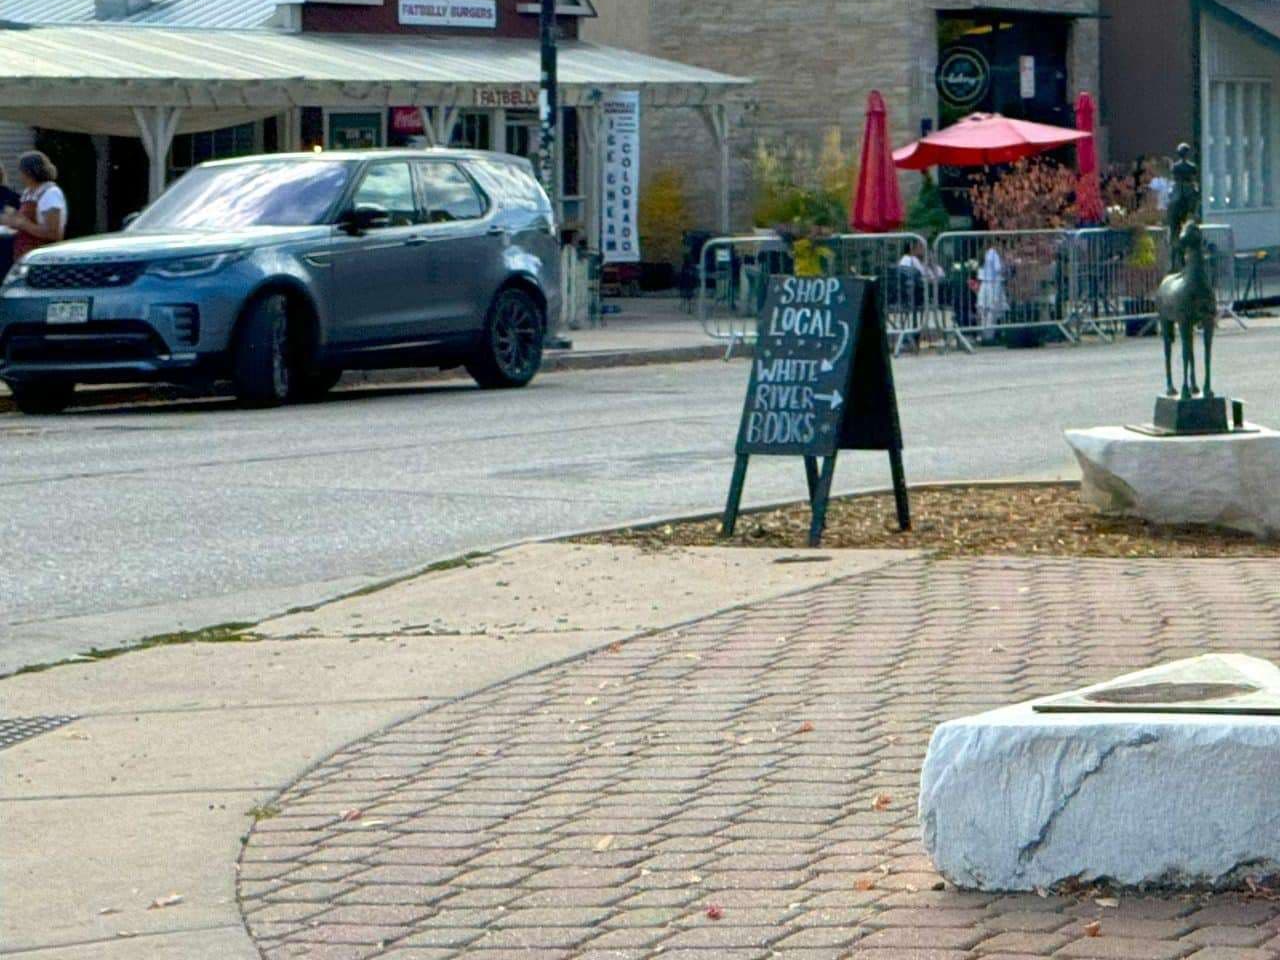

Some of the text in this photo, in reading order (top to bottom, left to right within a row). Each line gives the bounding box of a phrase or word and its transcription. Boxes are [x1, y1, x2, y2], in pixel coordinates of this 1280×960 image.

[402, 4, 494, 19] FATBELLY BURGERS
[481, 88, 539, 106] FATBELLY
[780, 277, 840, 305] SHOP
[768, 306, 837, 338] LOCAL
[756, 359, 818, 382] WHITE
[754, 383, 816, 411] RIVER
[746, 410, 816, 444] BOOKS
